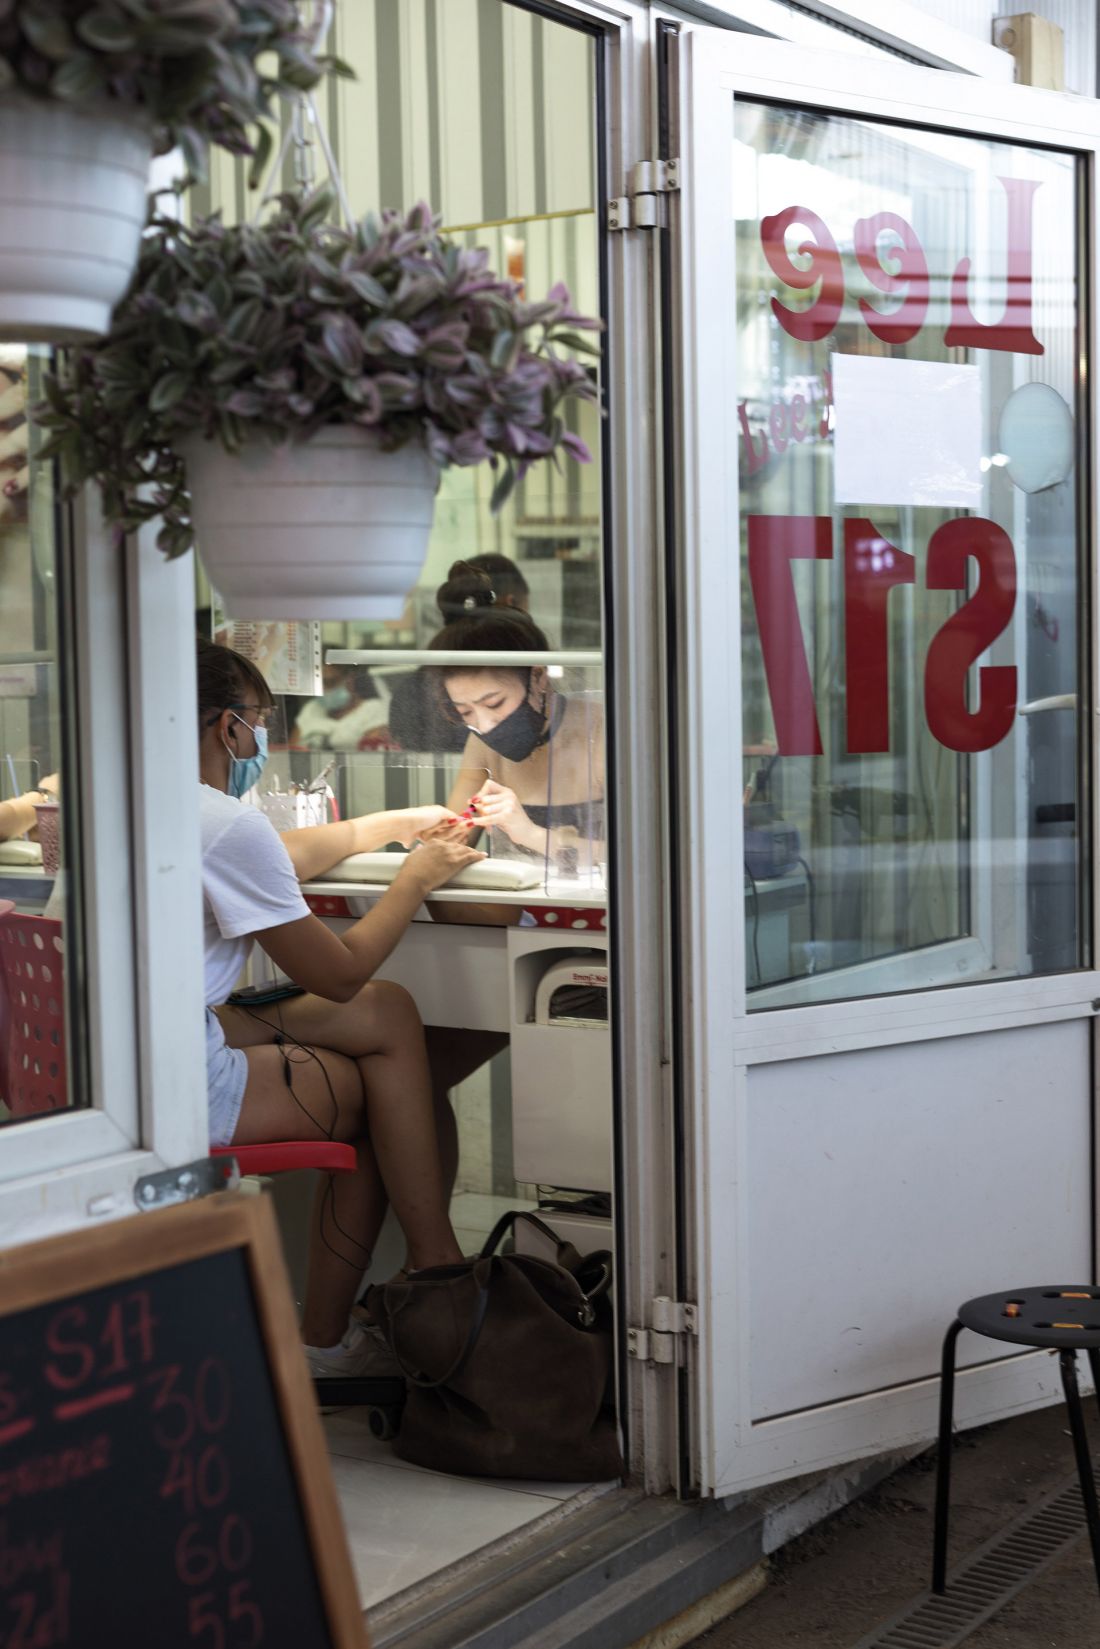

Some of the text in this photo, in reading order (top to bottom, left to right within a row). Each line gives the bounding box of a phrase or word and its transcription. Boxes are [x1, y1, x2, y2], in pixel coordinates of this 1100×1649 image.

[44, 1290, 158, 1391] S17
[144, 1356, 231, 1449] 30
[160, 1445, 230, 1513] 40
[174, 1512, 253, 1586] 60
[188, 1578, 263, 1649] 55
